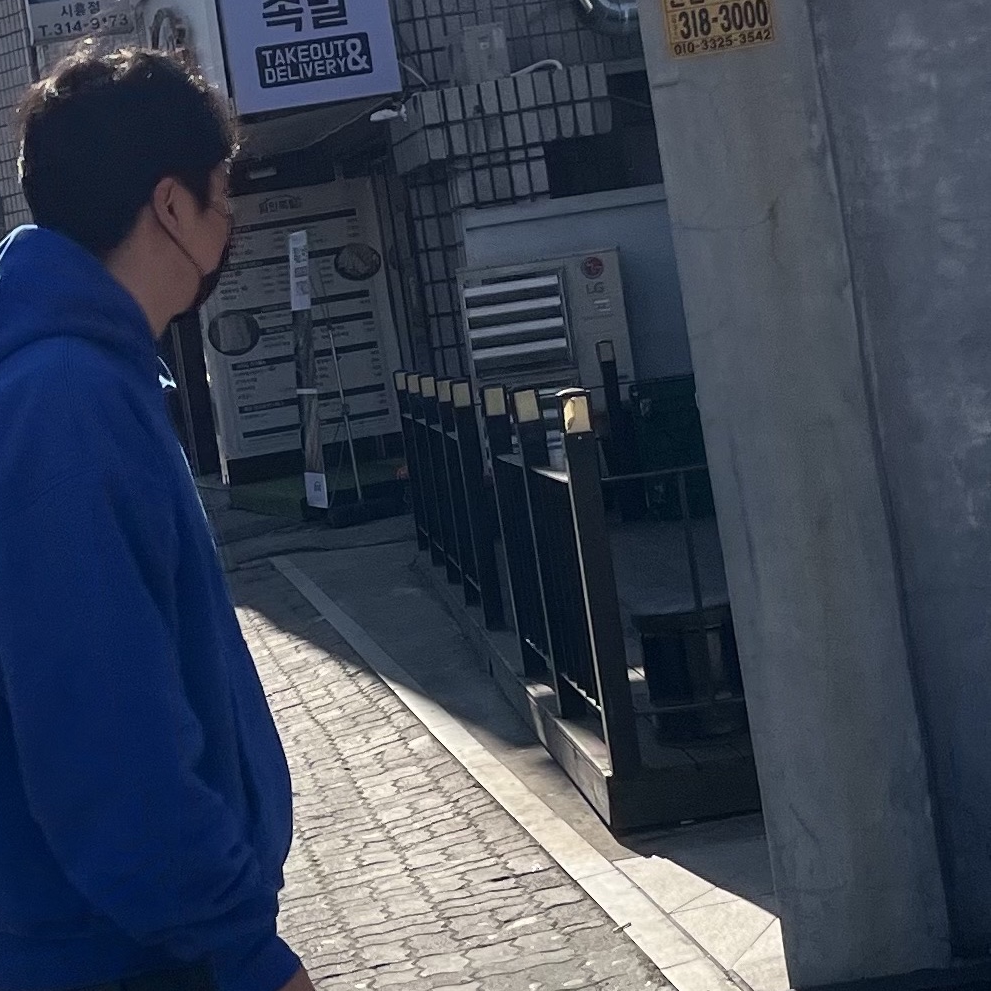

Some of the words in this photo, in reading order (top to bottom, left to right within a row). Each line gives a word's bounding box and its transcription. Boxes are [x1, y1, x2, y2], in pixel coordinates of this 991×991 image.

[678, 0, 769, 40] 318-3000
[262, 40, 345, 67] TAKEOUT
[345, 38, 370, 71] &
[674, 28, 771, 56] 010-3325-3542
[264, 57, 347, 84] DELIVERY
